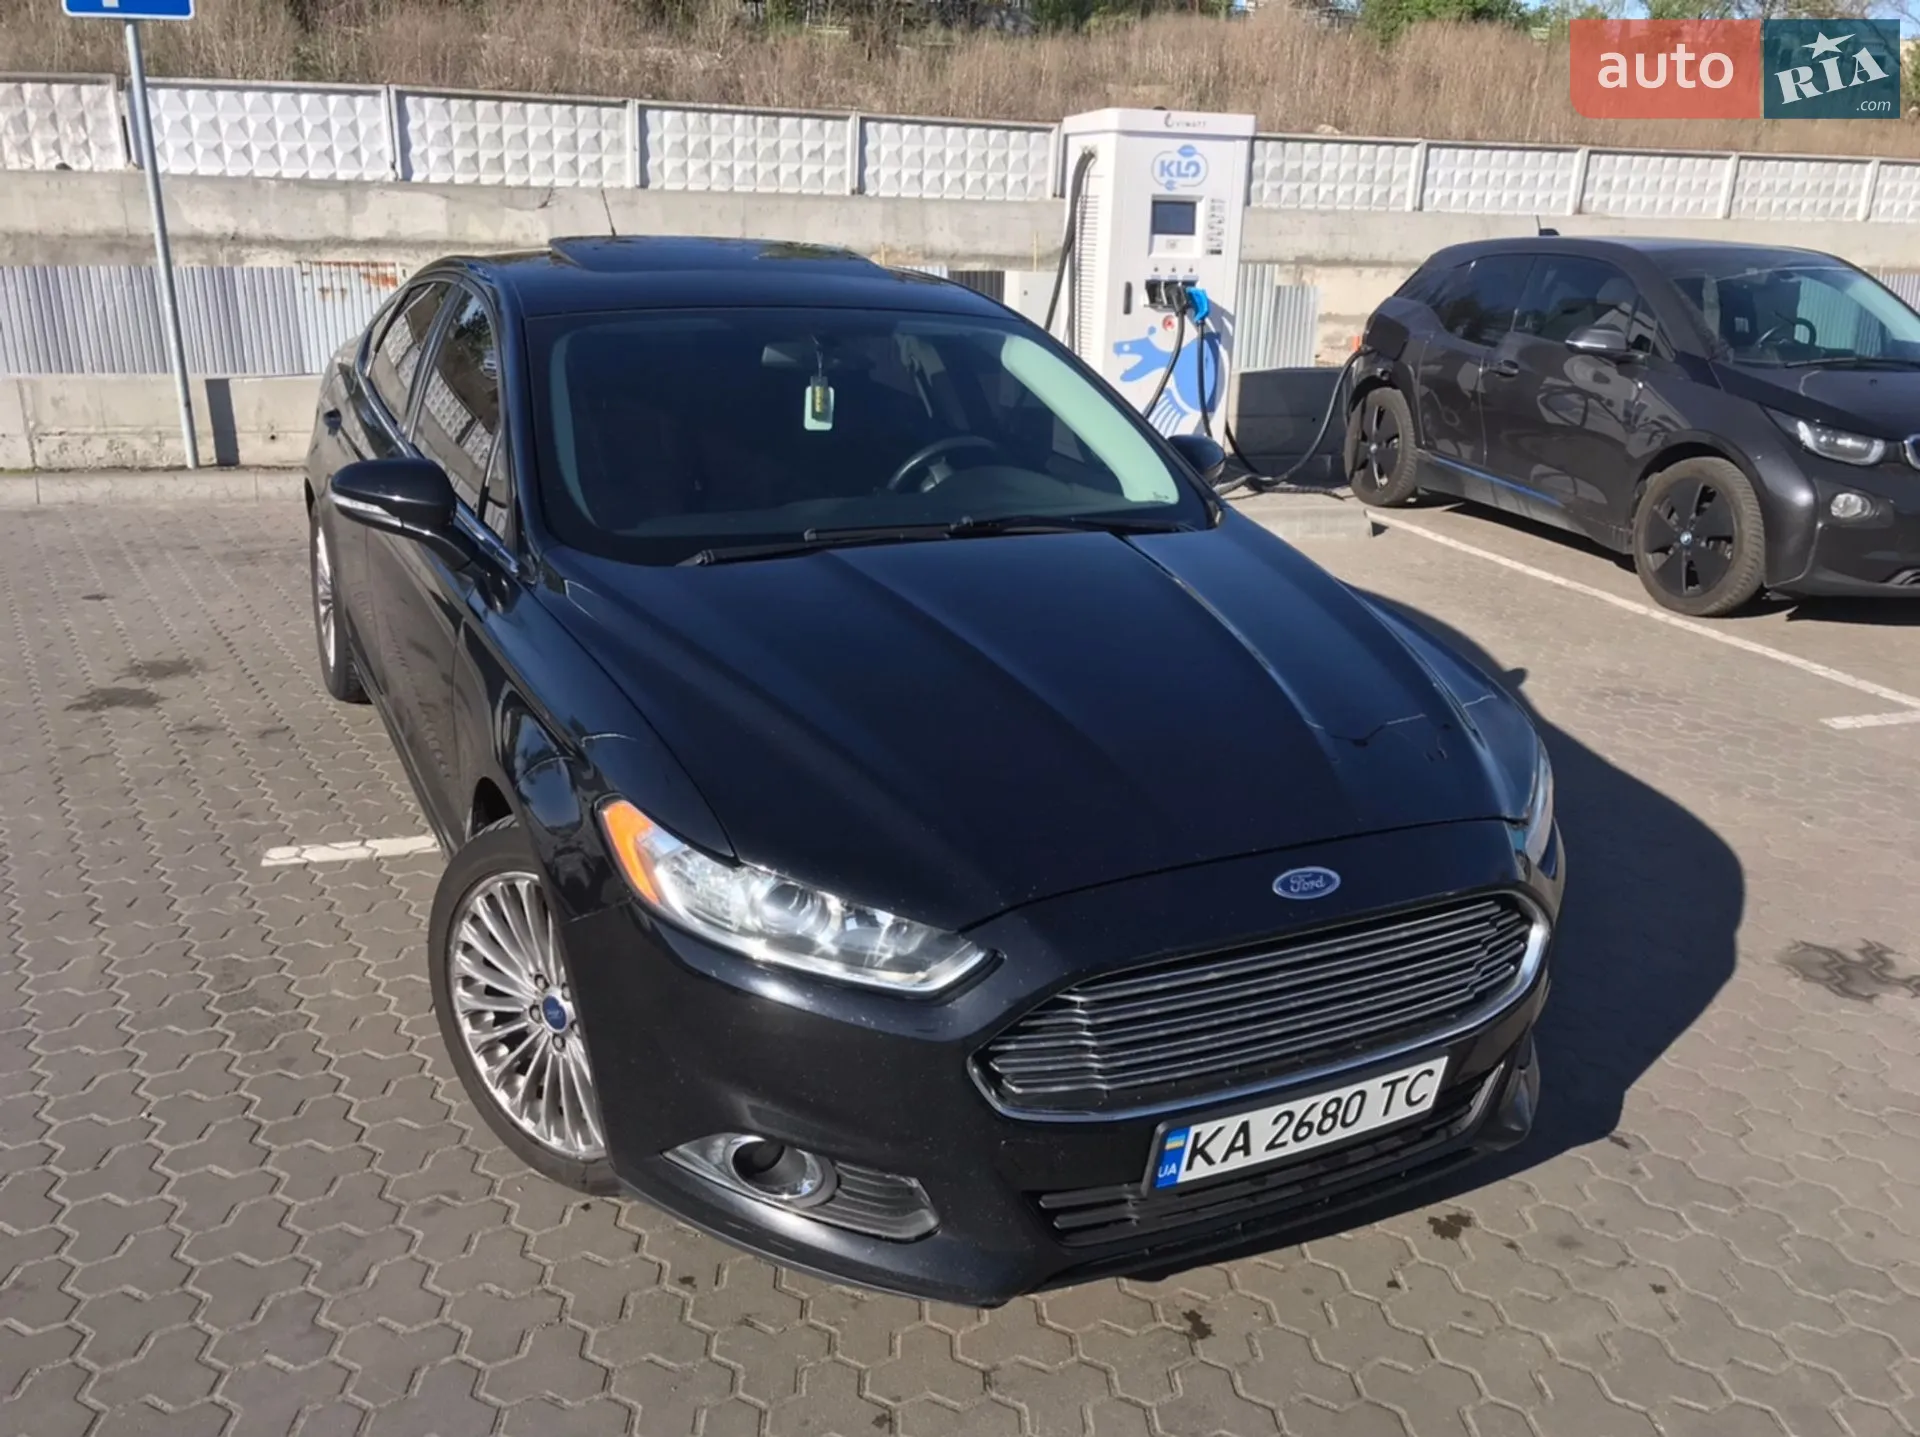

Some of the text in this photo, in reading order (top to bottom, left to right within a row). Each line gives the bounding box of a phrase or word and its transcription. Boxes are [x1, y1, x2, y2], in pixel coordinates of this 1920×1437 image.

[1290, 873, 1325, 893] Ford
[1185, 1069, 1434, 1172] KA 2680 TC
[1157, 1163, 1177, 1178] UA
